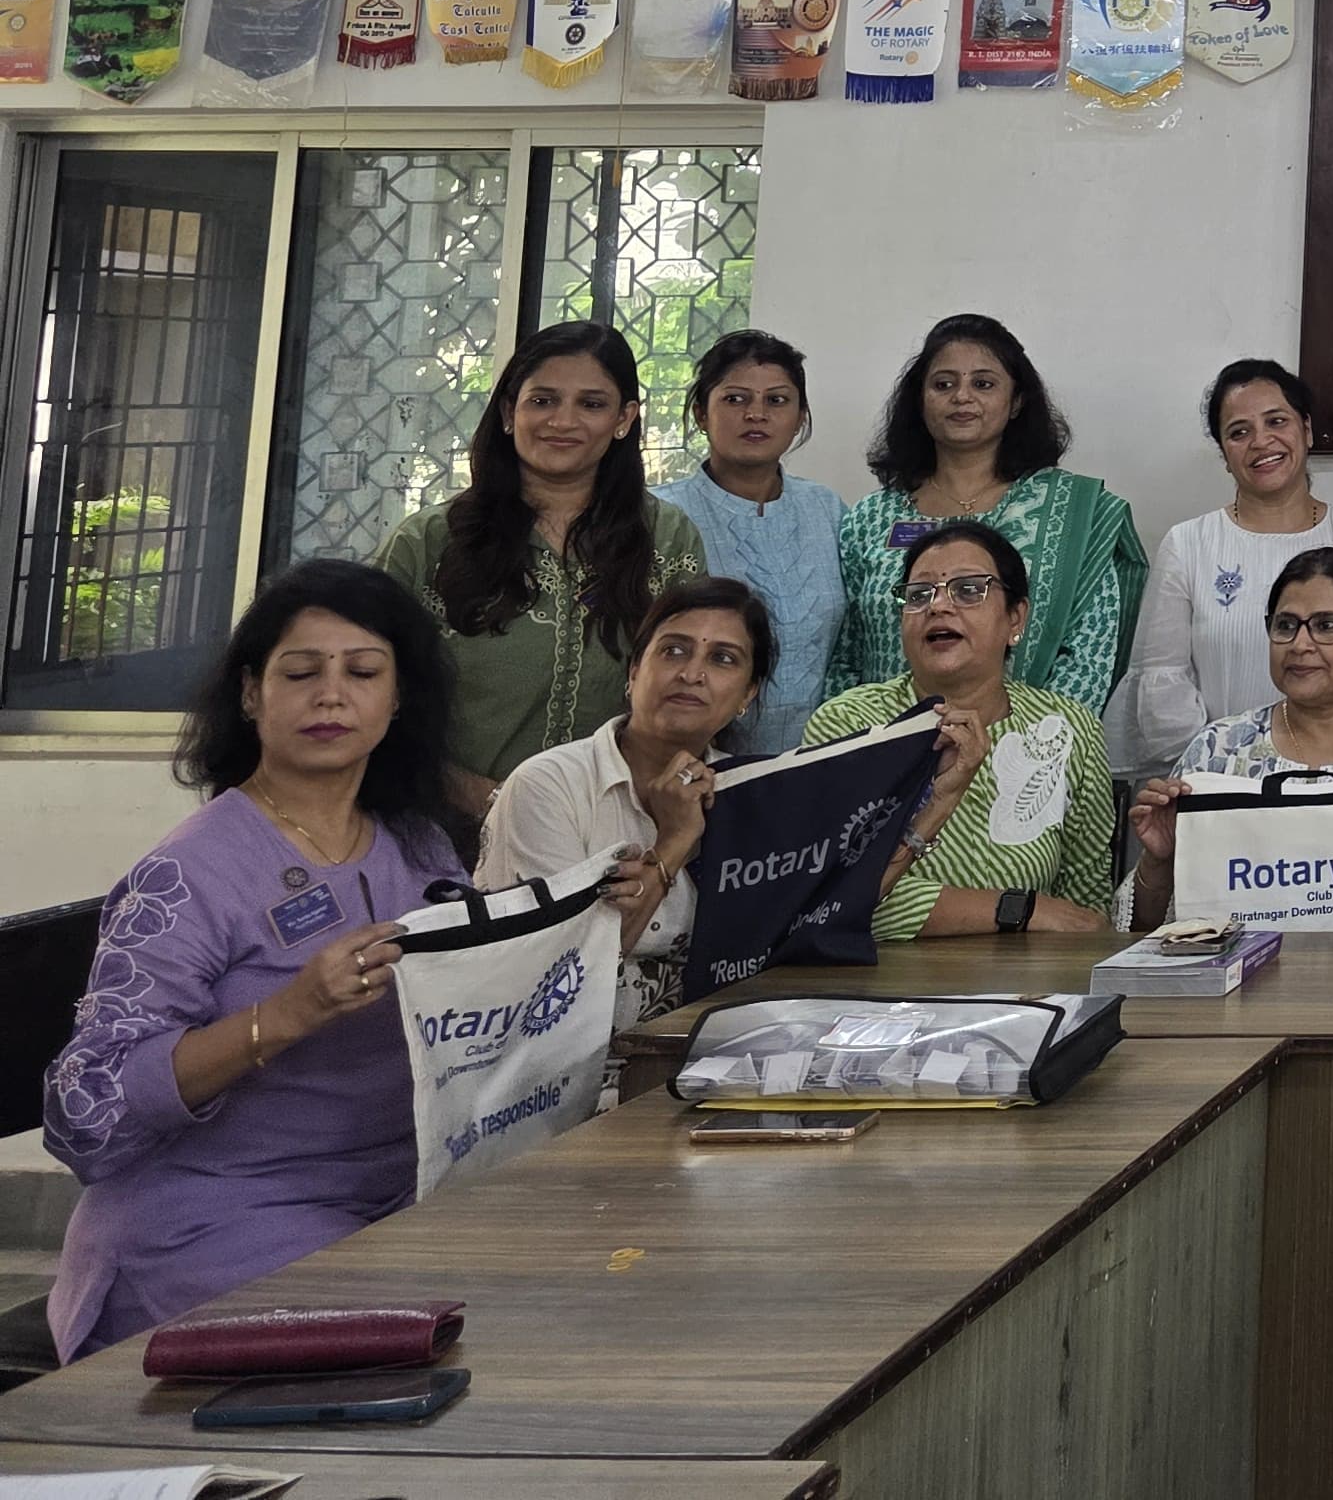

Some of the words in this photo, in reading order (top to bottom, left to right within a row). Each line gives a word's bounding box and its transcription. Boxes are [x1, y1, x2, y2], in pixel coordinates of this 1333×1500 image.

[865, 27, 891, 36] THE
[894, 26, 934, 37] MAGIC
[1236, 26, 1249, 42] of
[1253, 24, 1289, 37] Love
[871, 39, 887, 47] OF
[890, 38, 929, 47] ROTARY
[880, 54, 903, 62] Rotary
[718, 838, 830, 892] Rotary
[1307, 890, 1332, 902] Club
[1231, 910, 1288, 923] Biratnagar
